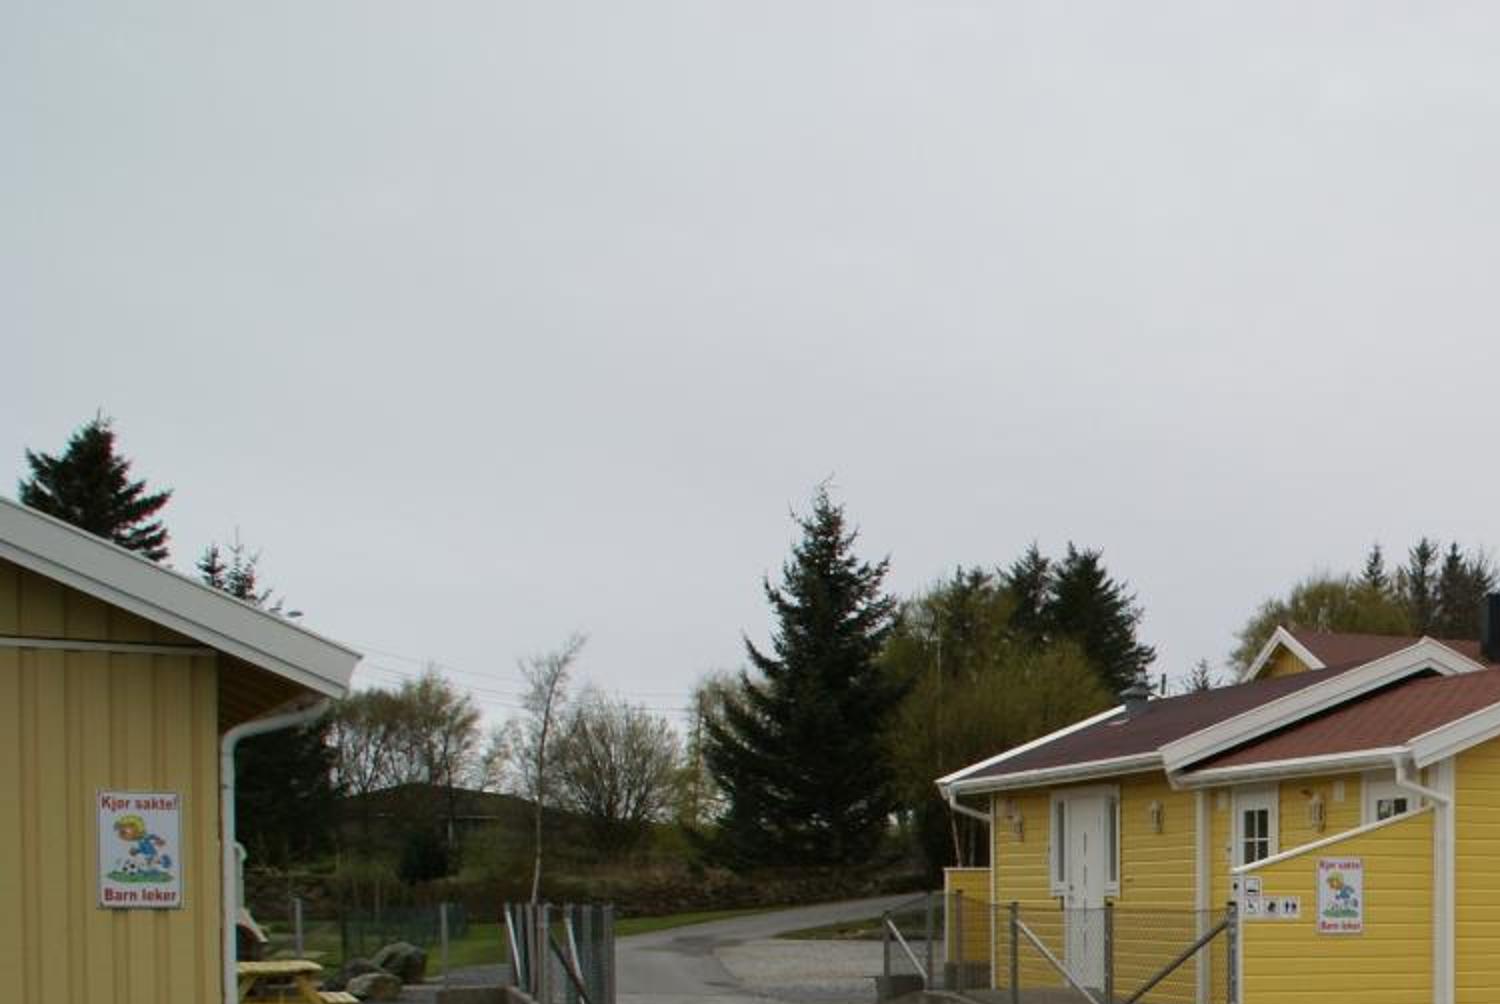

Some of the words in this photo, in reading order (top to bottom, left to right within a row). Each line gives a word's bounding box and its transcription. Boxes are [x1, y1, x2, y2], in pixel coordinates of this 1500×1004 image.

[135, 796, 177, 810] sakte!
[104, 887, 137, 901] Barn
[141, 887, 177, 901] leker
